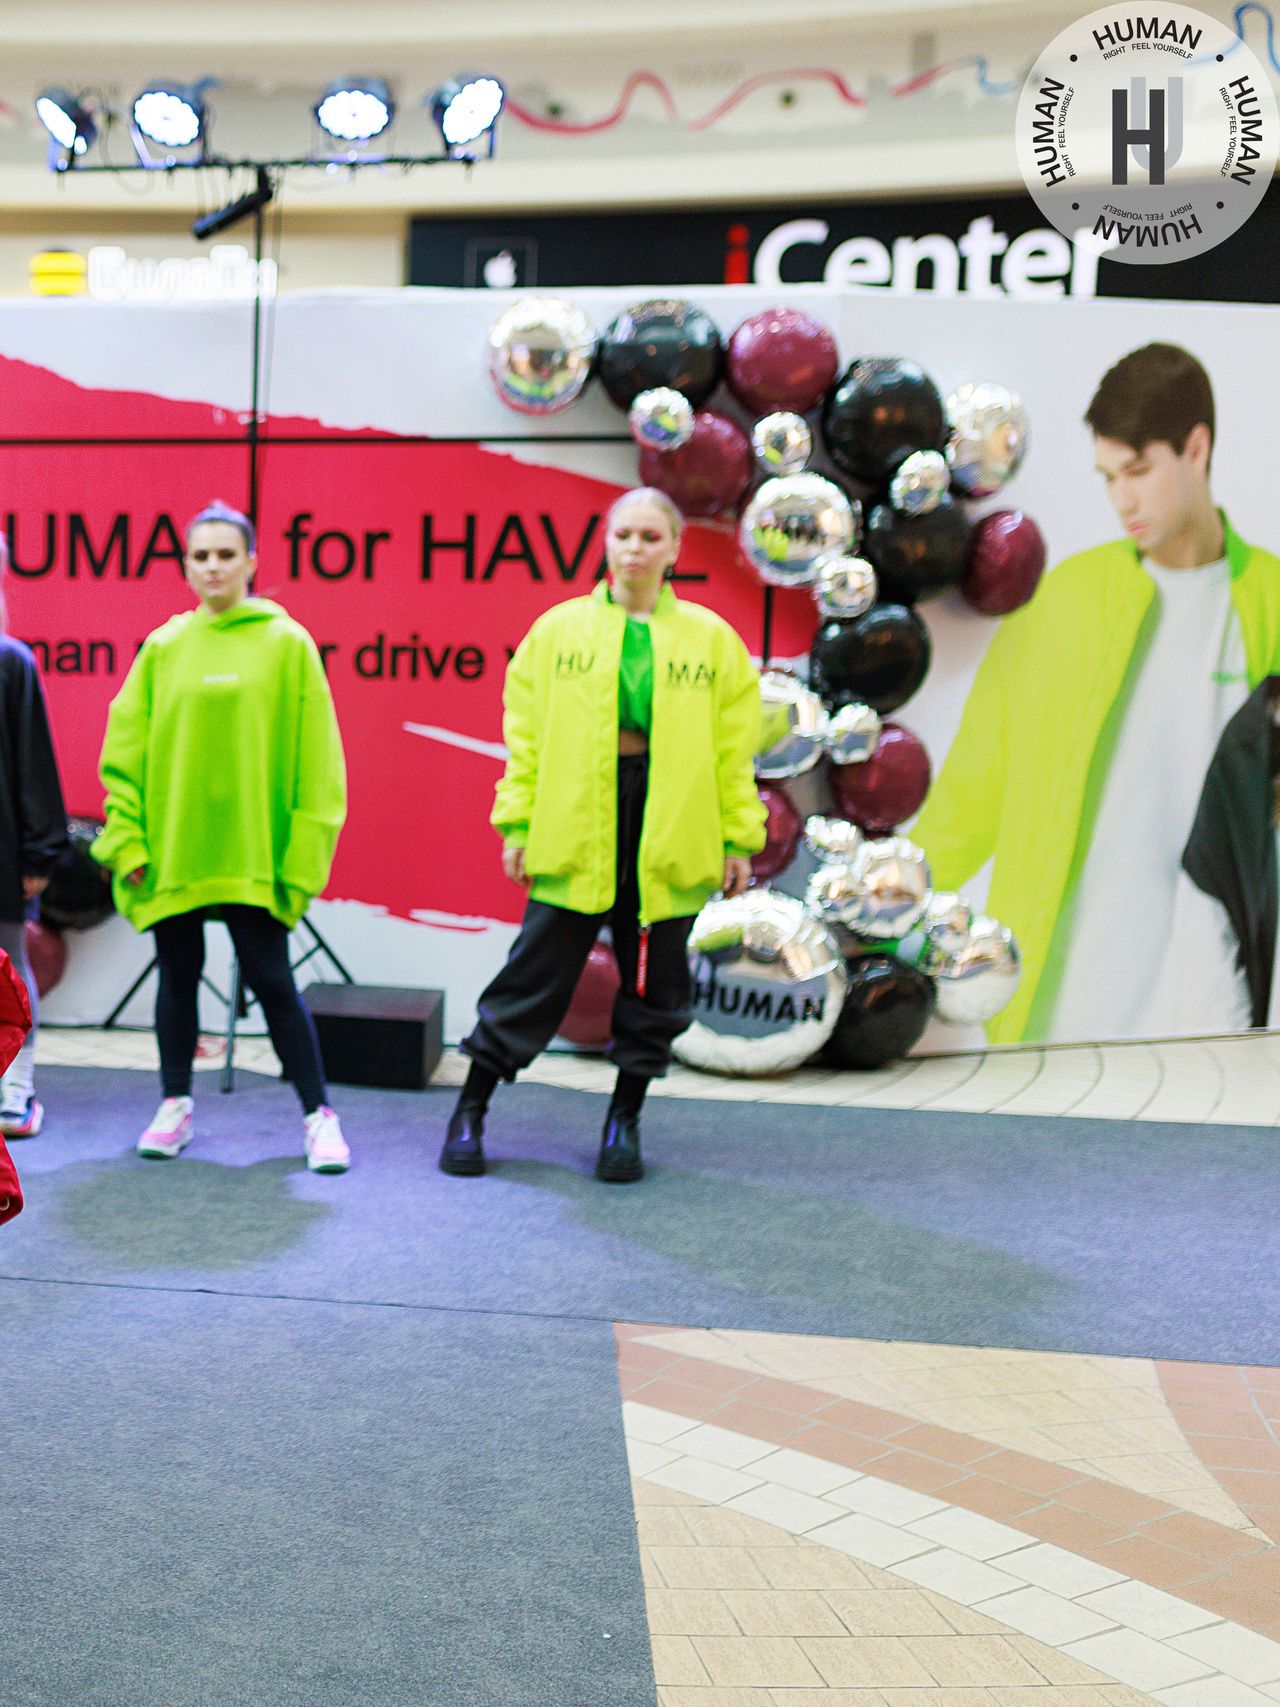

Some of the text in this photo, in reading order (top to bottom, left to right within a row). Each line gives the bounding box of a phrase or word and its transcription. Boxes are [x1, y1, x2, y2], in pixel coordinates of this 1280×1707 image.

[725, 215, 1120, 298] iCenter
[285, 514, 389, 580] for
[355, 633, 485, 679] drive
[556, 653, 595, 674] HU
[693, 982, 826, 1023] HUMAN
